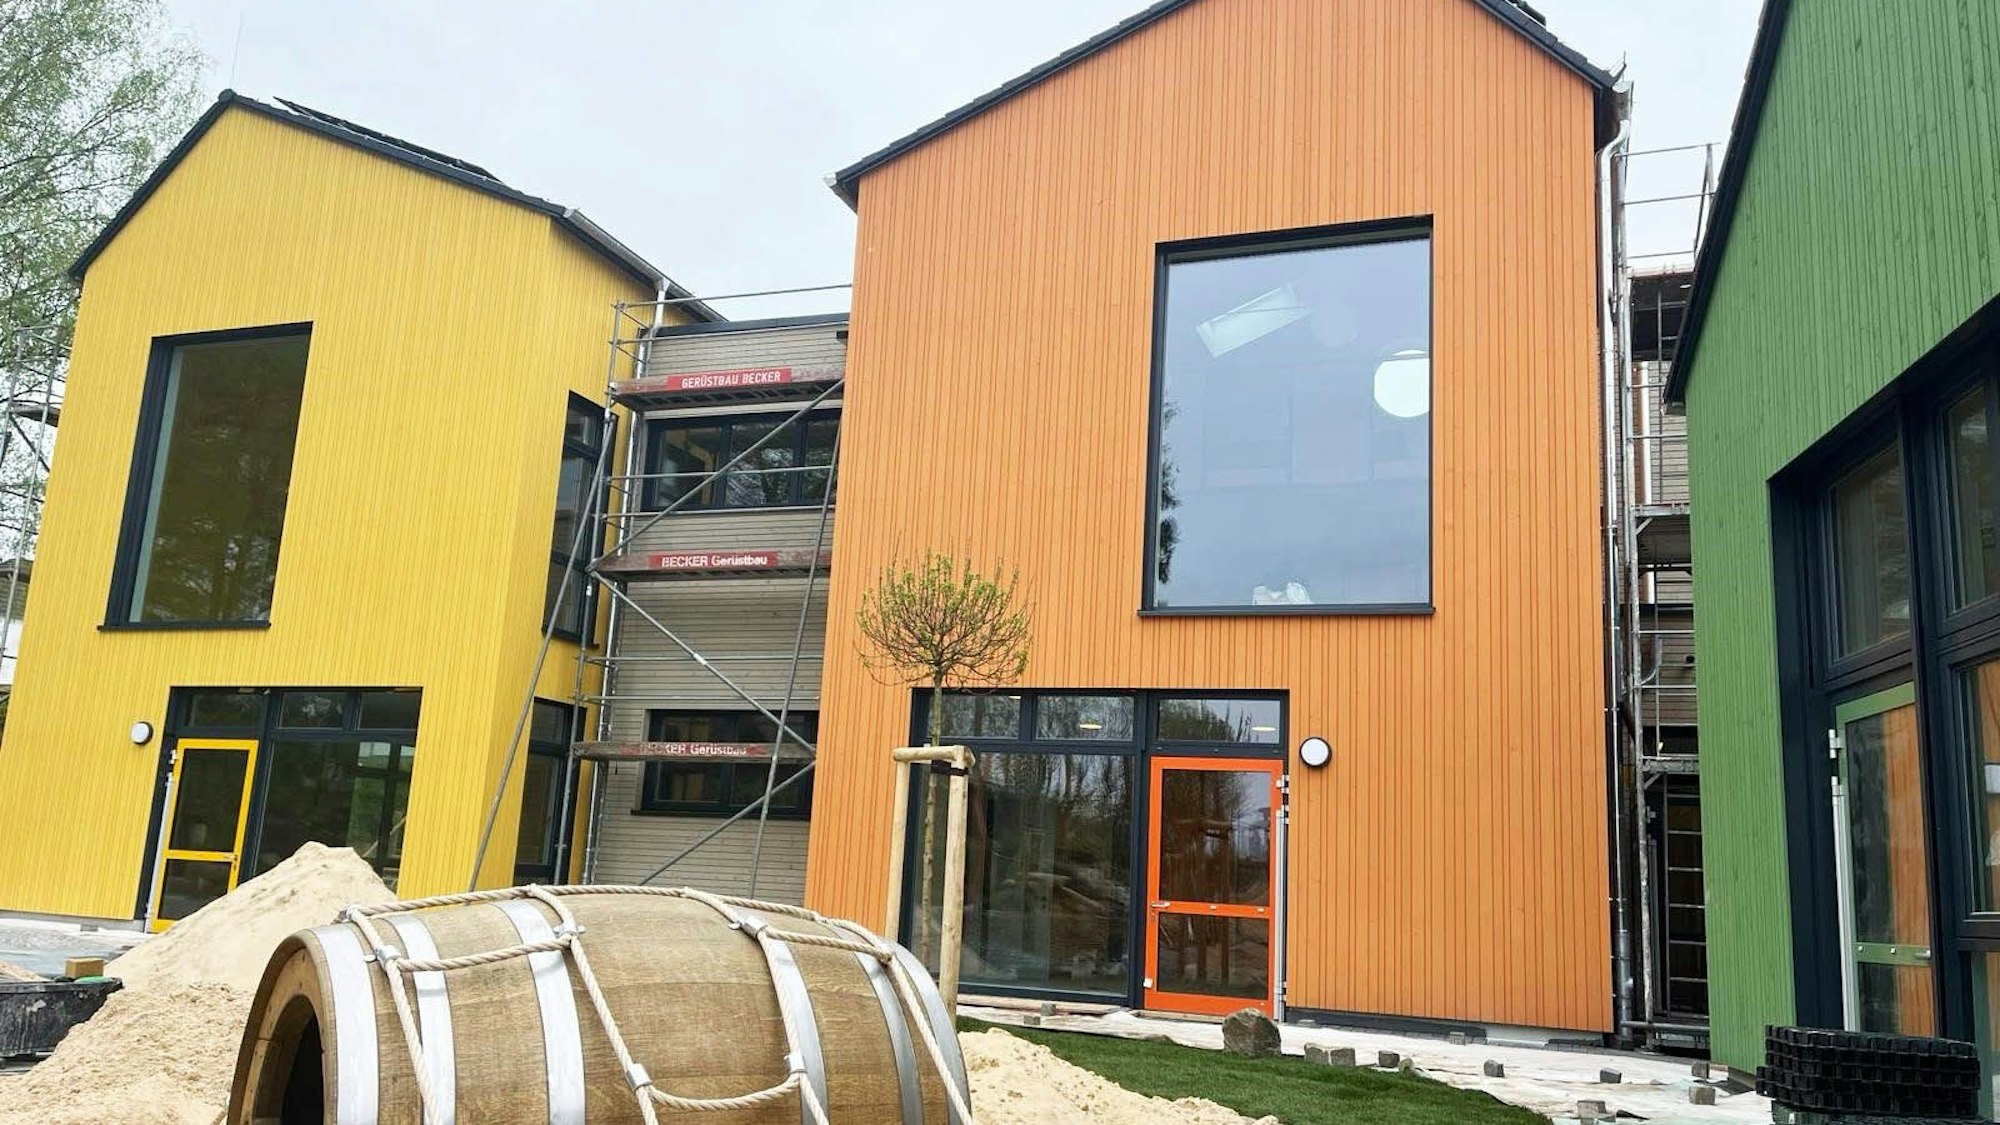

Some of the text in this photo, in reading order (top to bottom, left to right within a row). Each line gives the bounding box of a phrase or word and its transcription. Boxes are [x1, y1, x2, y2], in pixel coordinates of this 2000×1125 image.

[682, 371, 781, 389] GERÜSTBAU BECKER
[662, 554, 768, 567] BECKER Gerüstbau
